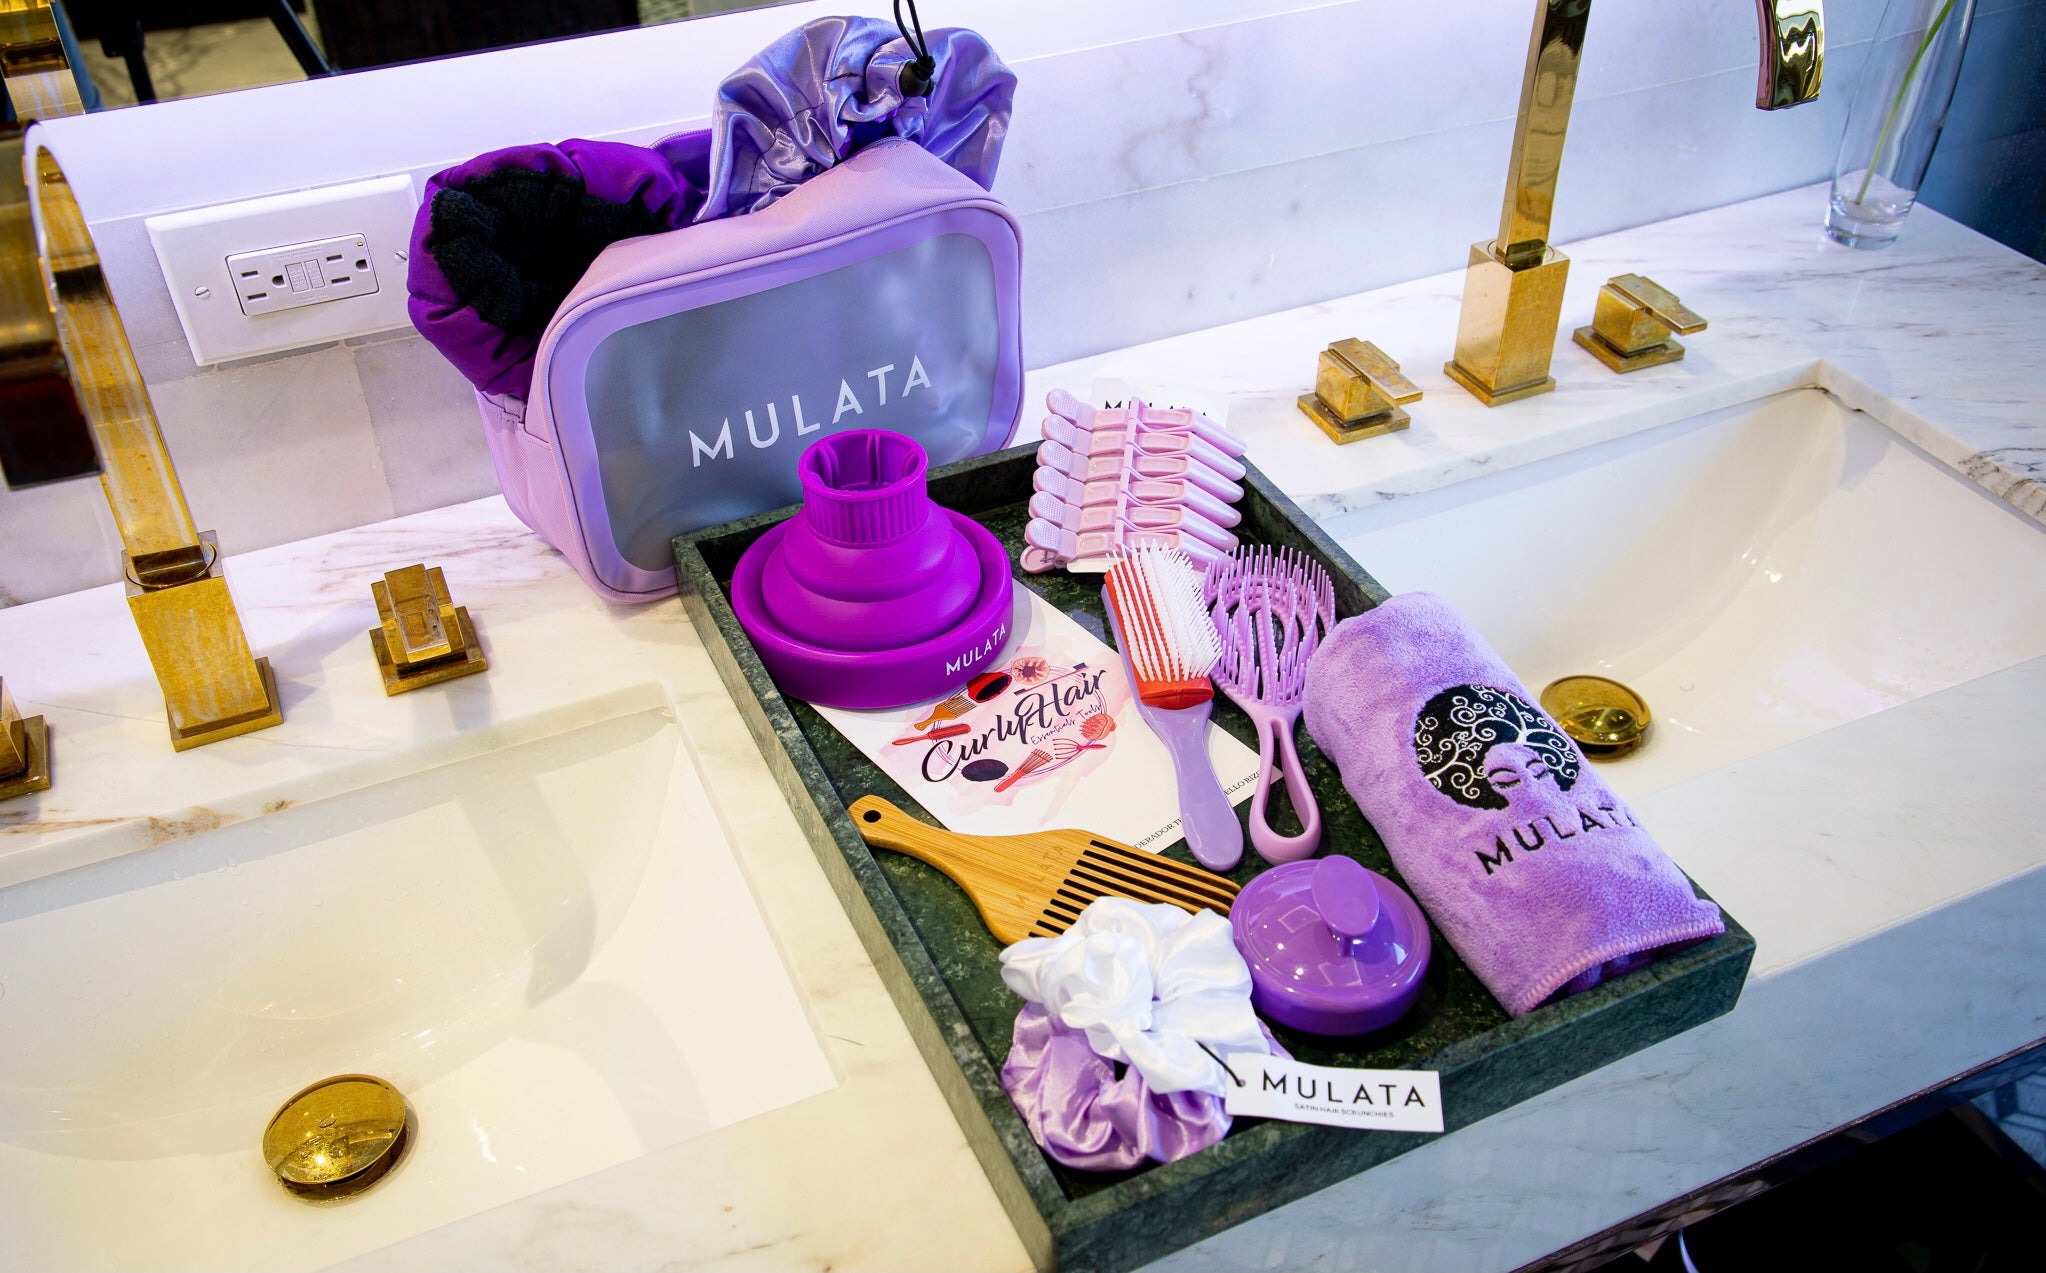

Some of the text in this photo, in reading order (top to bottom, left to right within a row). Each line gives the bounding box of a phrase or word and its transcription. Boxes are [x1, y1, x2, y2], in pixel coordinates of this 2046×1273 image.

[688, 354, 932, 468] MULATA
[946, 623, 1006, 676] MULATA
[921, 668, 1107, 783] Curly Hair
[1030, 703, 1102, 746] Essentials Tools
[1263, 1069, 1426, 1107] MULATA
[1294, 1103, 1319, 1112] SATIN
[1341, 1109, 1395, 1118] SCRUNCHIES
